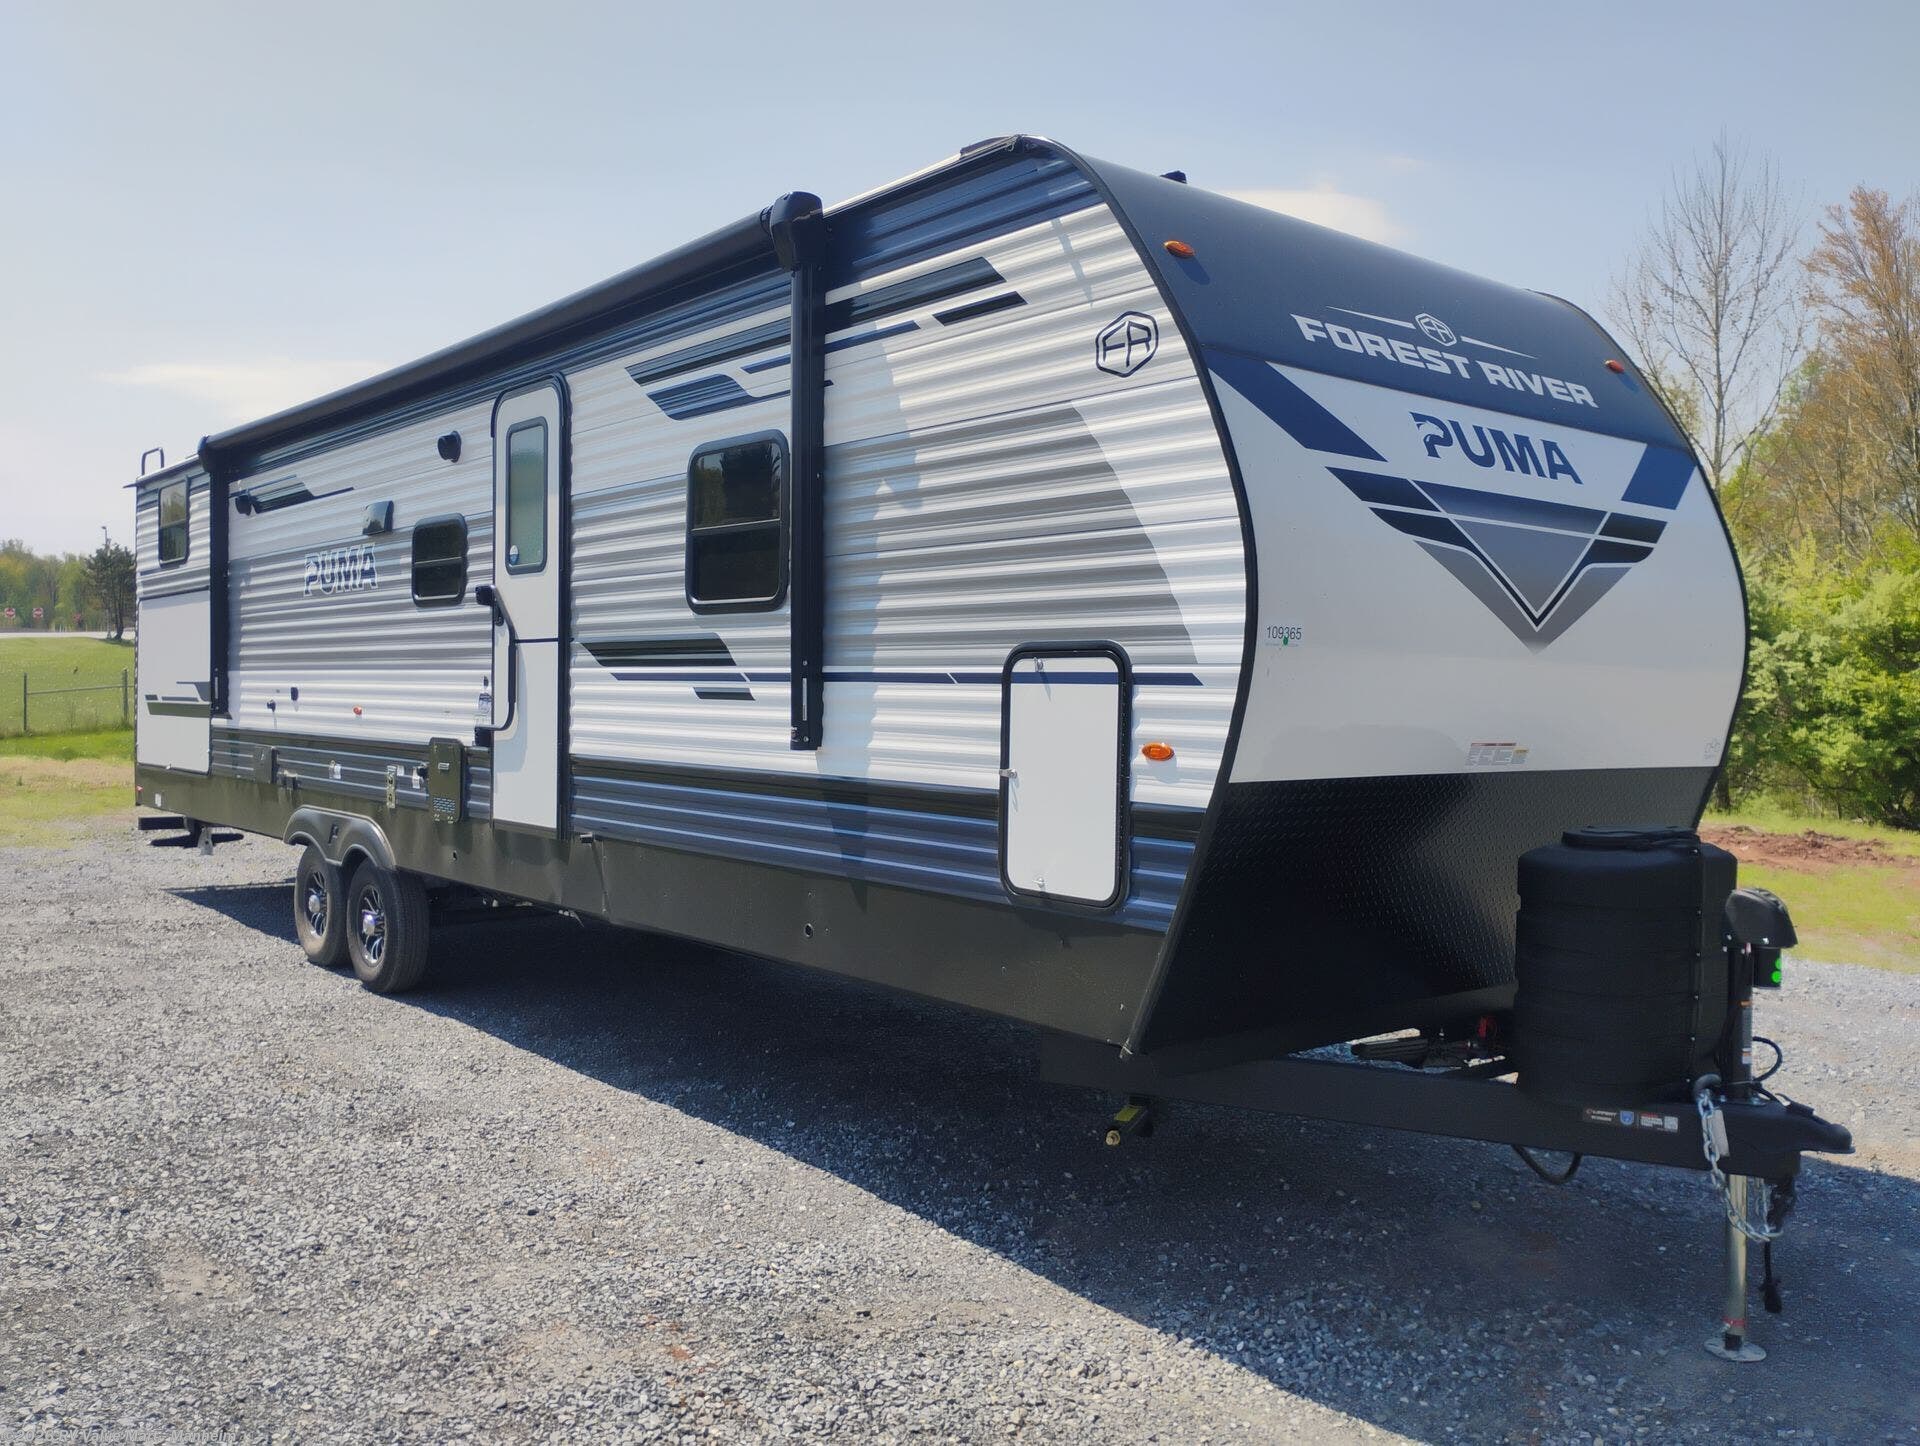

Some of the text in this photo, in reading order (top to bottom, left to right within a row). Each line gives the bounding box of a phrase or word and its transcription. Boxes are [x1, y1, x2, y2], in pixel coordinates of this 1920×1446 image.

[1290, 313, 1600, 409] FOREST RIVER
[1409, 411, 1584, 485] PUMA
[304, 543, 378, 596] PUMA
[1266, 625, 1302, 640] 109365
